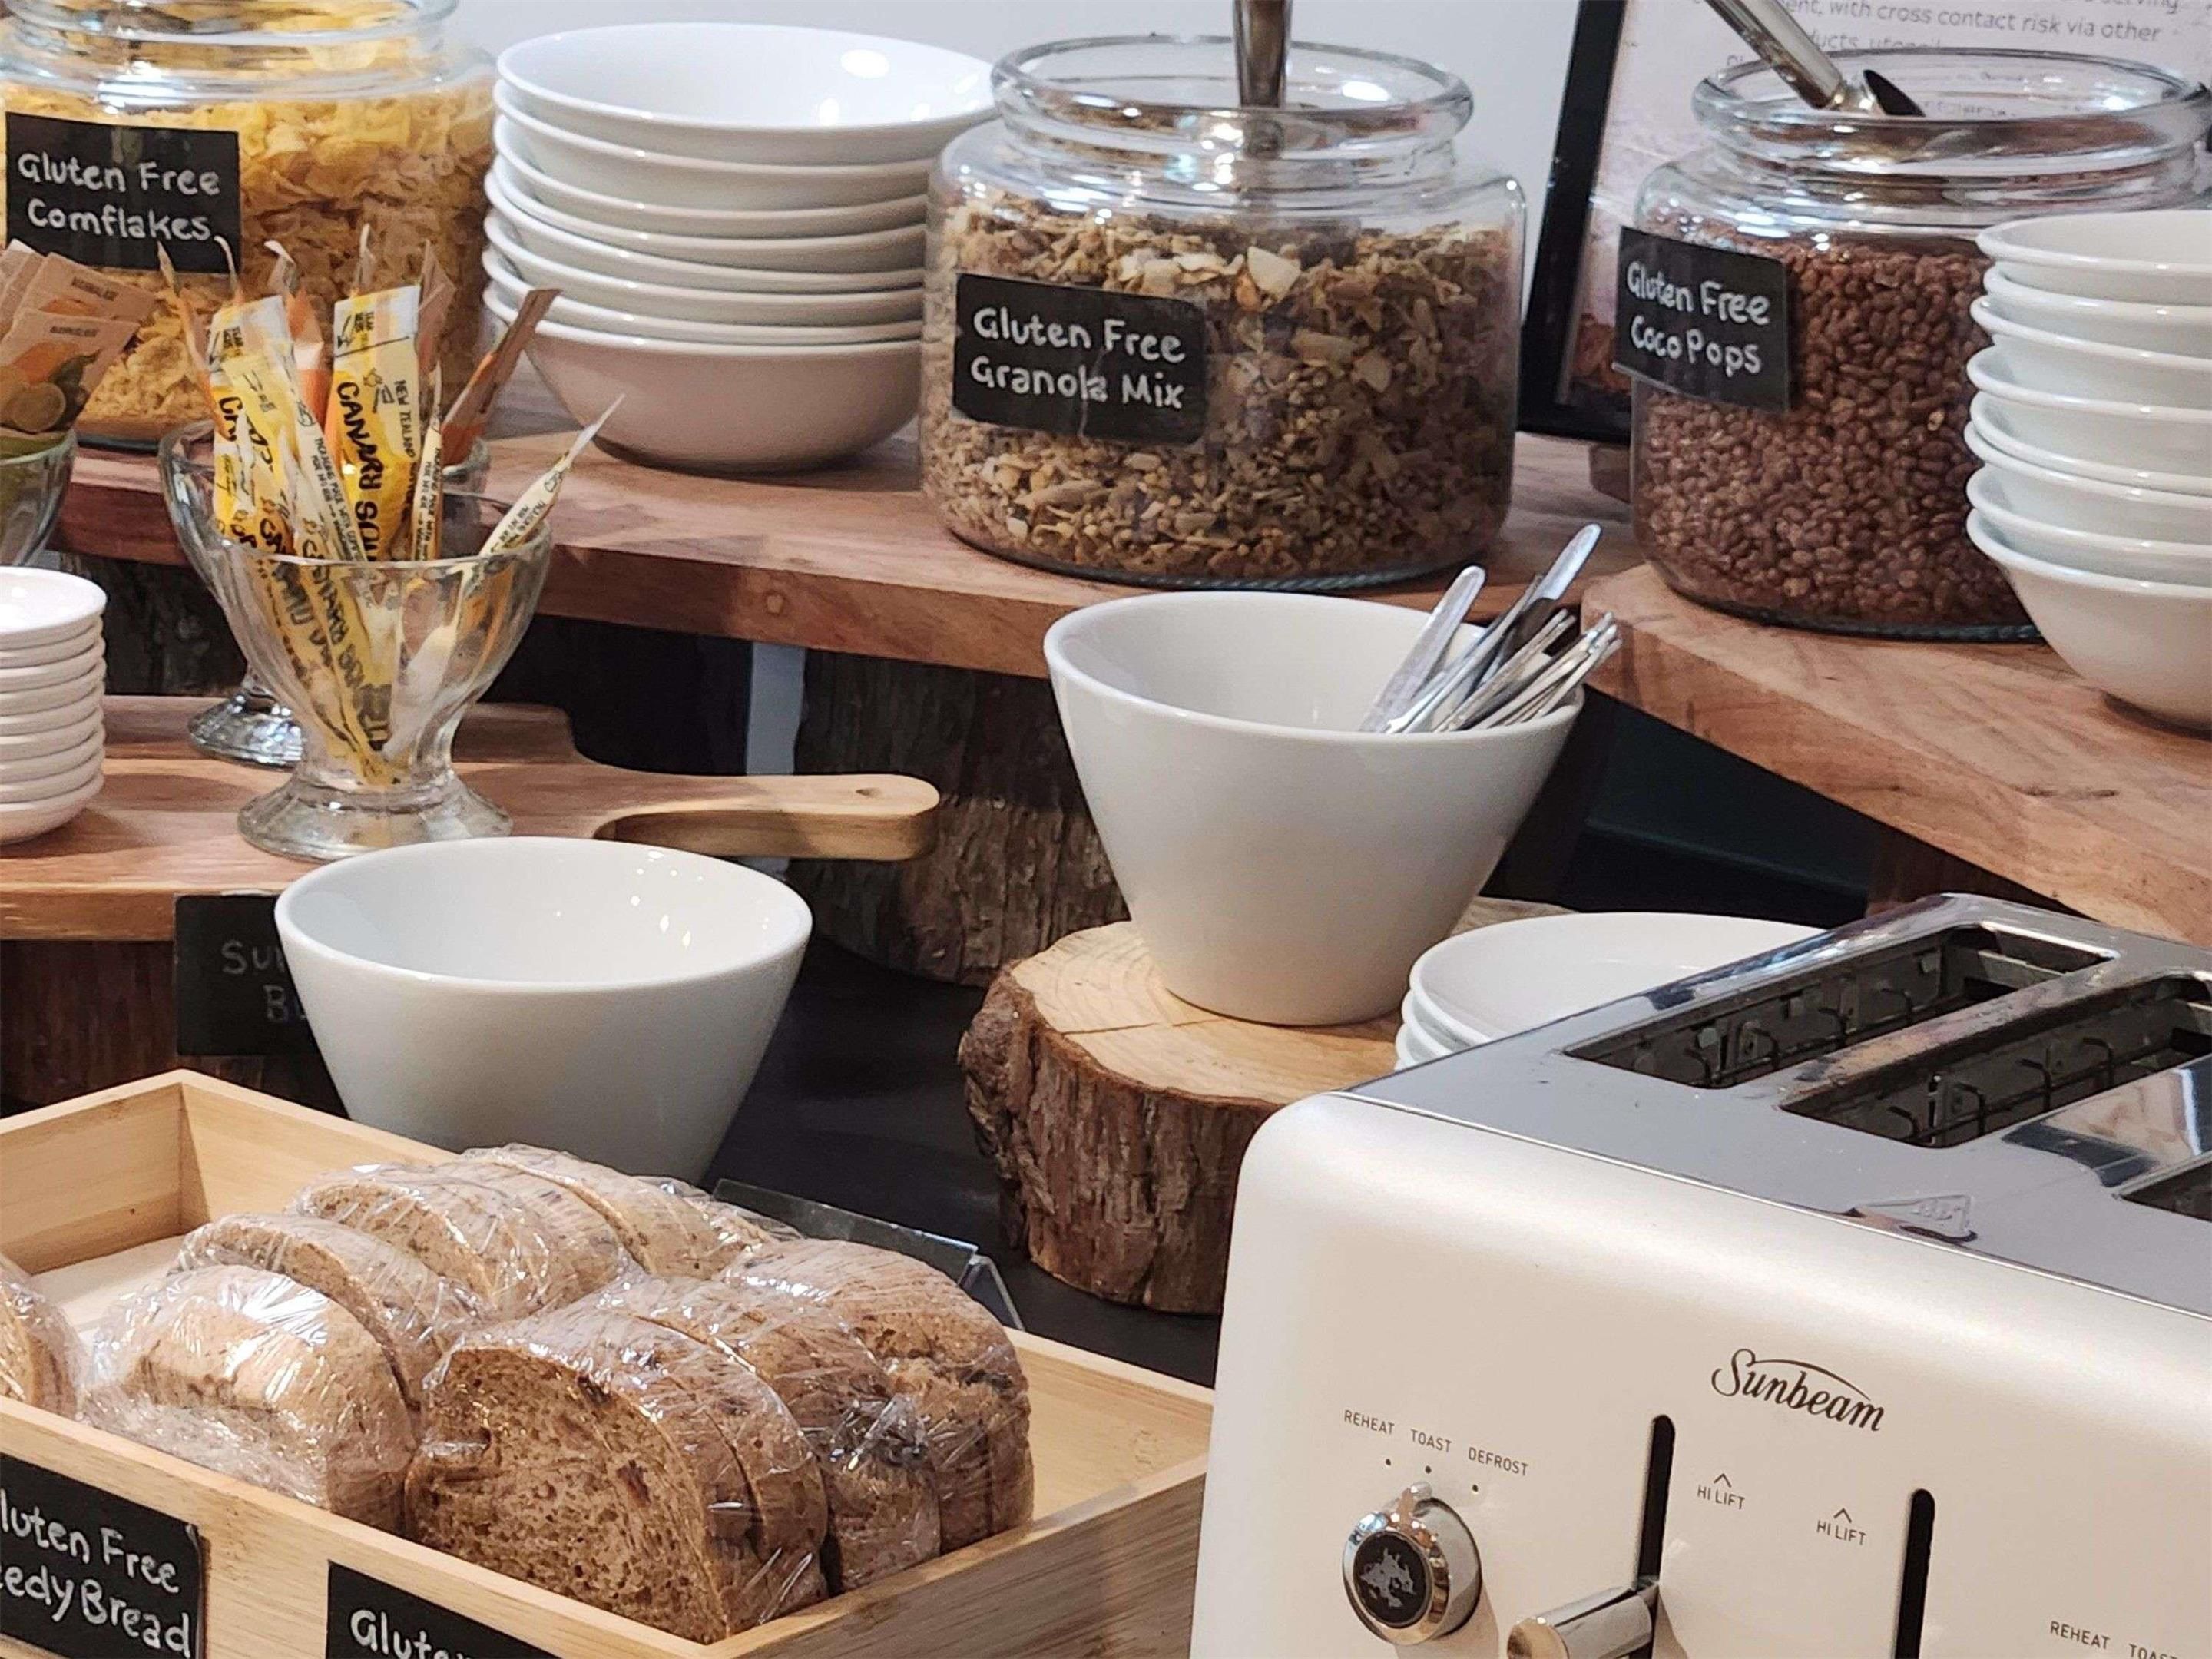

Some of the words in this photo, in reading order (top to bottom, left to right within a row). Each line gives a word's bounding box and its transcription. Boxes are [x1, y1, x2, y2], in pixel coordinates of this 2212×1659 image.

[1830, 1, 1871, 18] with
[1877, 6, 1932, 24] cross
[1938, 12, 2017, 31] contact
[2022, 15, 2060, 35] risk
[2067, 18, 2095, 38] via
[2101, 20, 2162, 41] other
[18, 151, 127, 192] Gluten
[138, 161, 220, 196] Free
[1627, 261, 1694, 313] Gluten
[1700, 280, 1770, 326] Free
[973, 306, 1092, 349] Gluten
[1104, 318, 1186, 363] Free
[1631, 315, 1684, 359] Coco
[1686, 329, 1763, 377] Pops
[970, 355, 1108, 403] Granola
[1121, 371, 1186, 409] Mix
[337, 382, 384, 492] CANARY
[1711, 1348, 1885, 1432] Sunbeam
[1344, 1409, 1395, 1435] REHEAT
[1410, 1429, 1452, 1453] TOAST
[1468, 1446, 1529, 1476] DEFROST
[1697, 1485, 1711, 1501] HI
[1715, 1489, 1745, 1510] LIFT
[0, 1488, 91, 1565] luten
[100, 1527, 180, 1594] Free
[1816, 1520, 1831, 1536] HI
[1835, 1525, 1867, 1545] LIFT
[0, 1565, 75, 1622] edy
[81, 1578, 191, 1659] Bread
[2050, 1621, 2111, 1650] REHEAT
